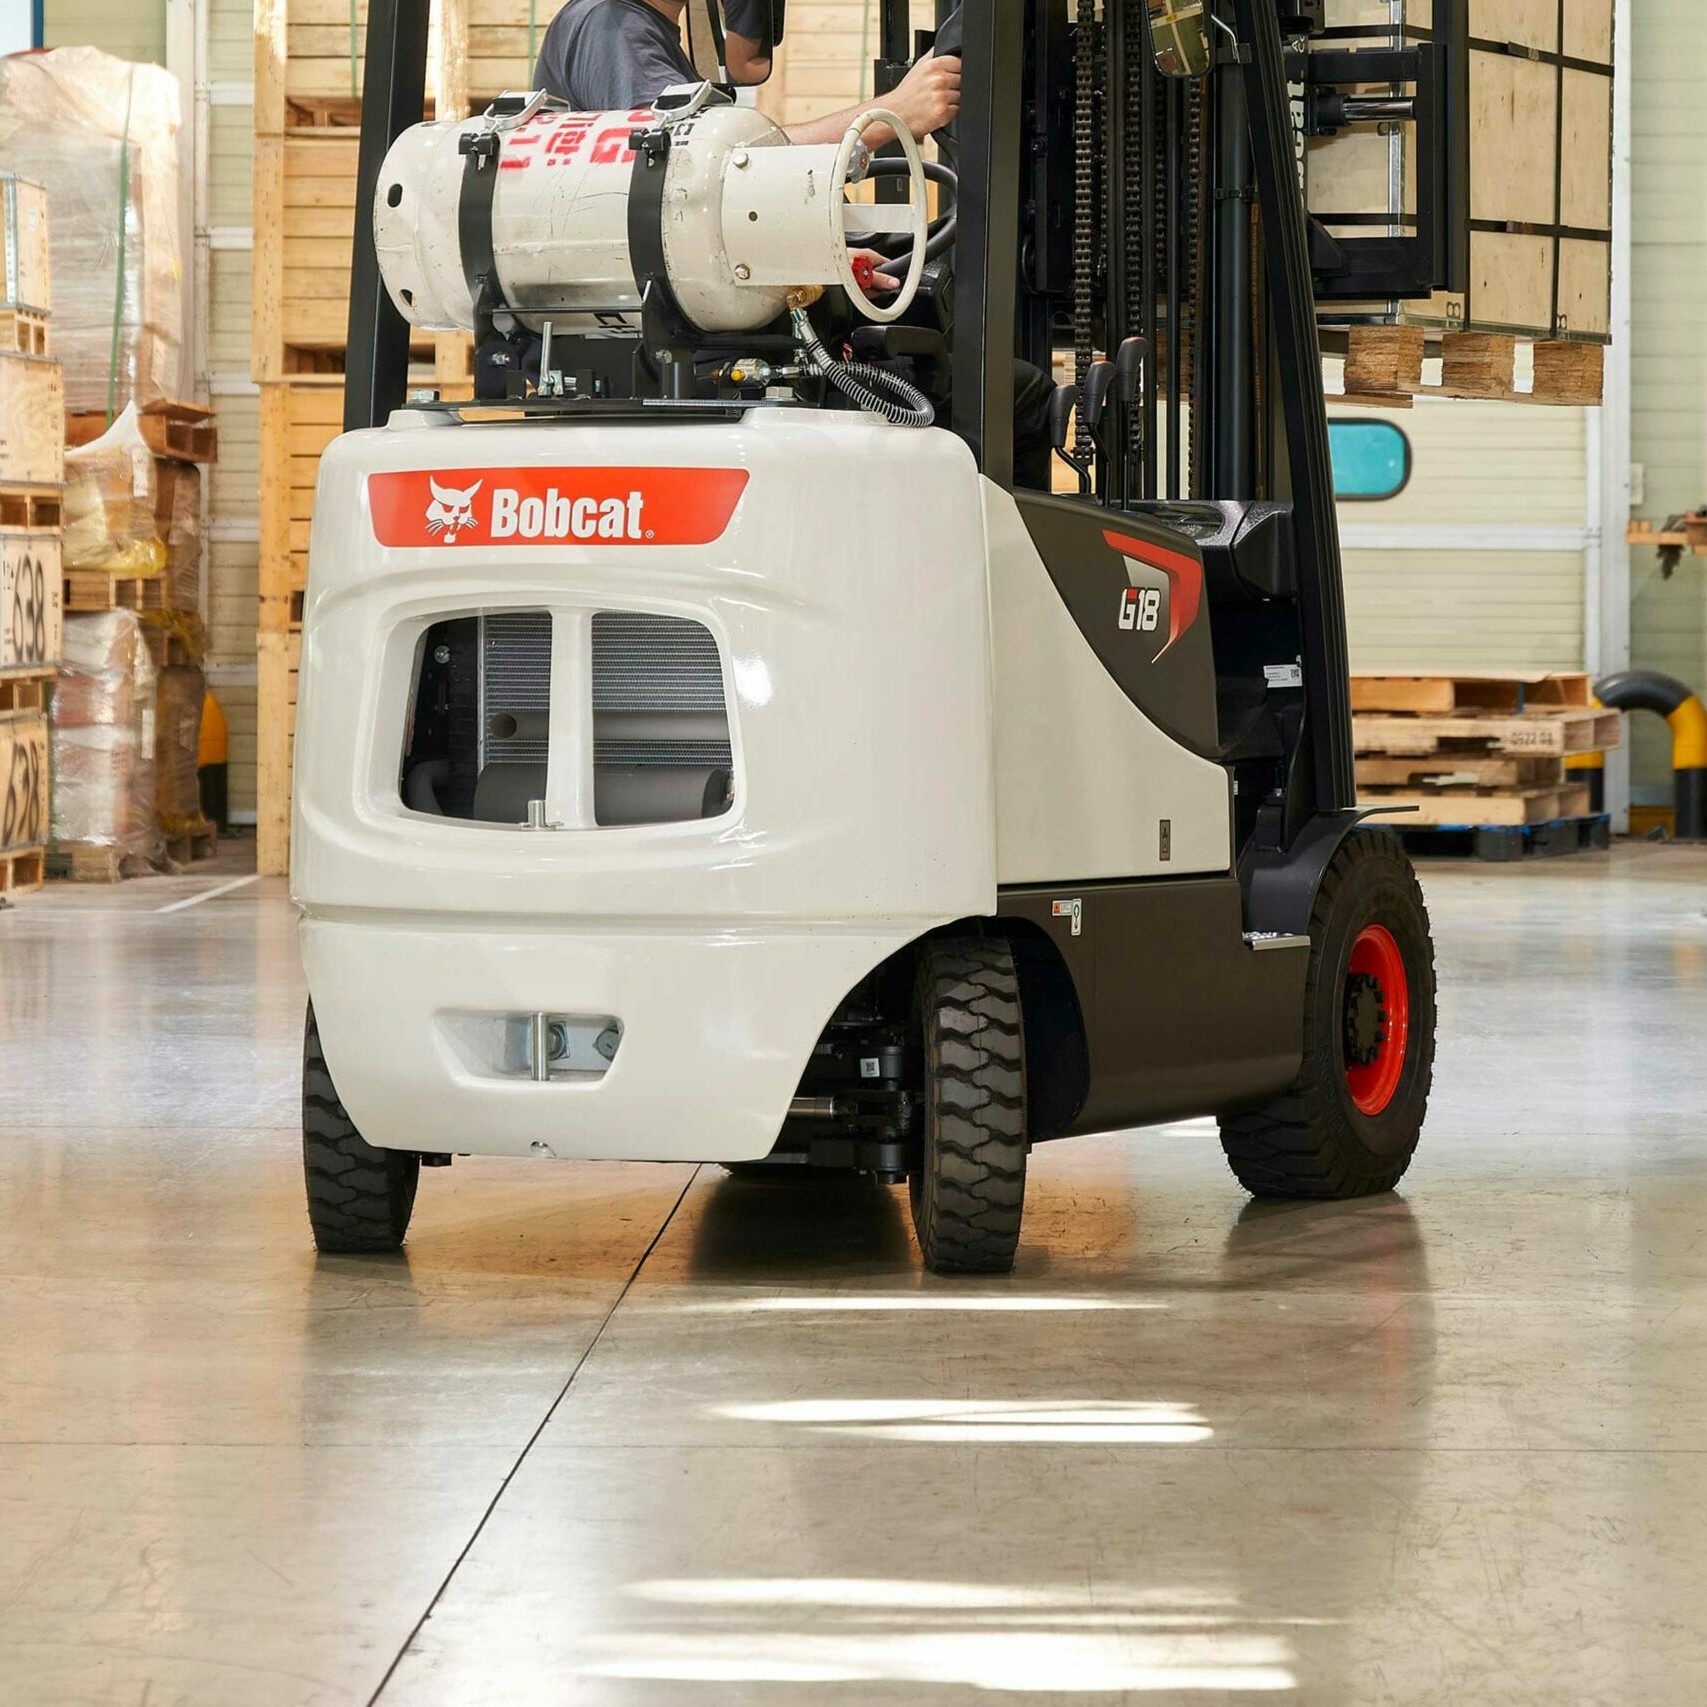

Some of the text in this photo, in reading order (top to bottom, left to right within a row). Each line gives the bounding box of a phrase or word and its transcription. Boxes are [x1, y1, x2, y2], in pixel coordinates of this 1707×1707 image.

[491, 488, 644, 540] Bobcat
[12, 554, 46, 663] 638
[1118, 587, 1161, 632] G18
